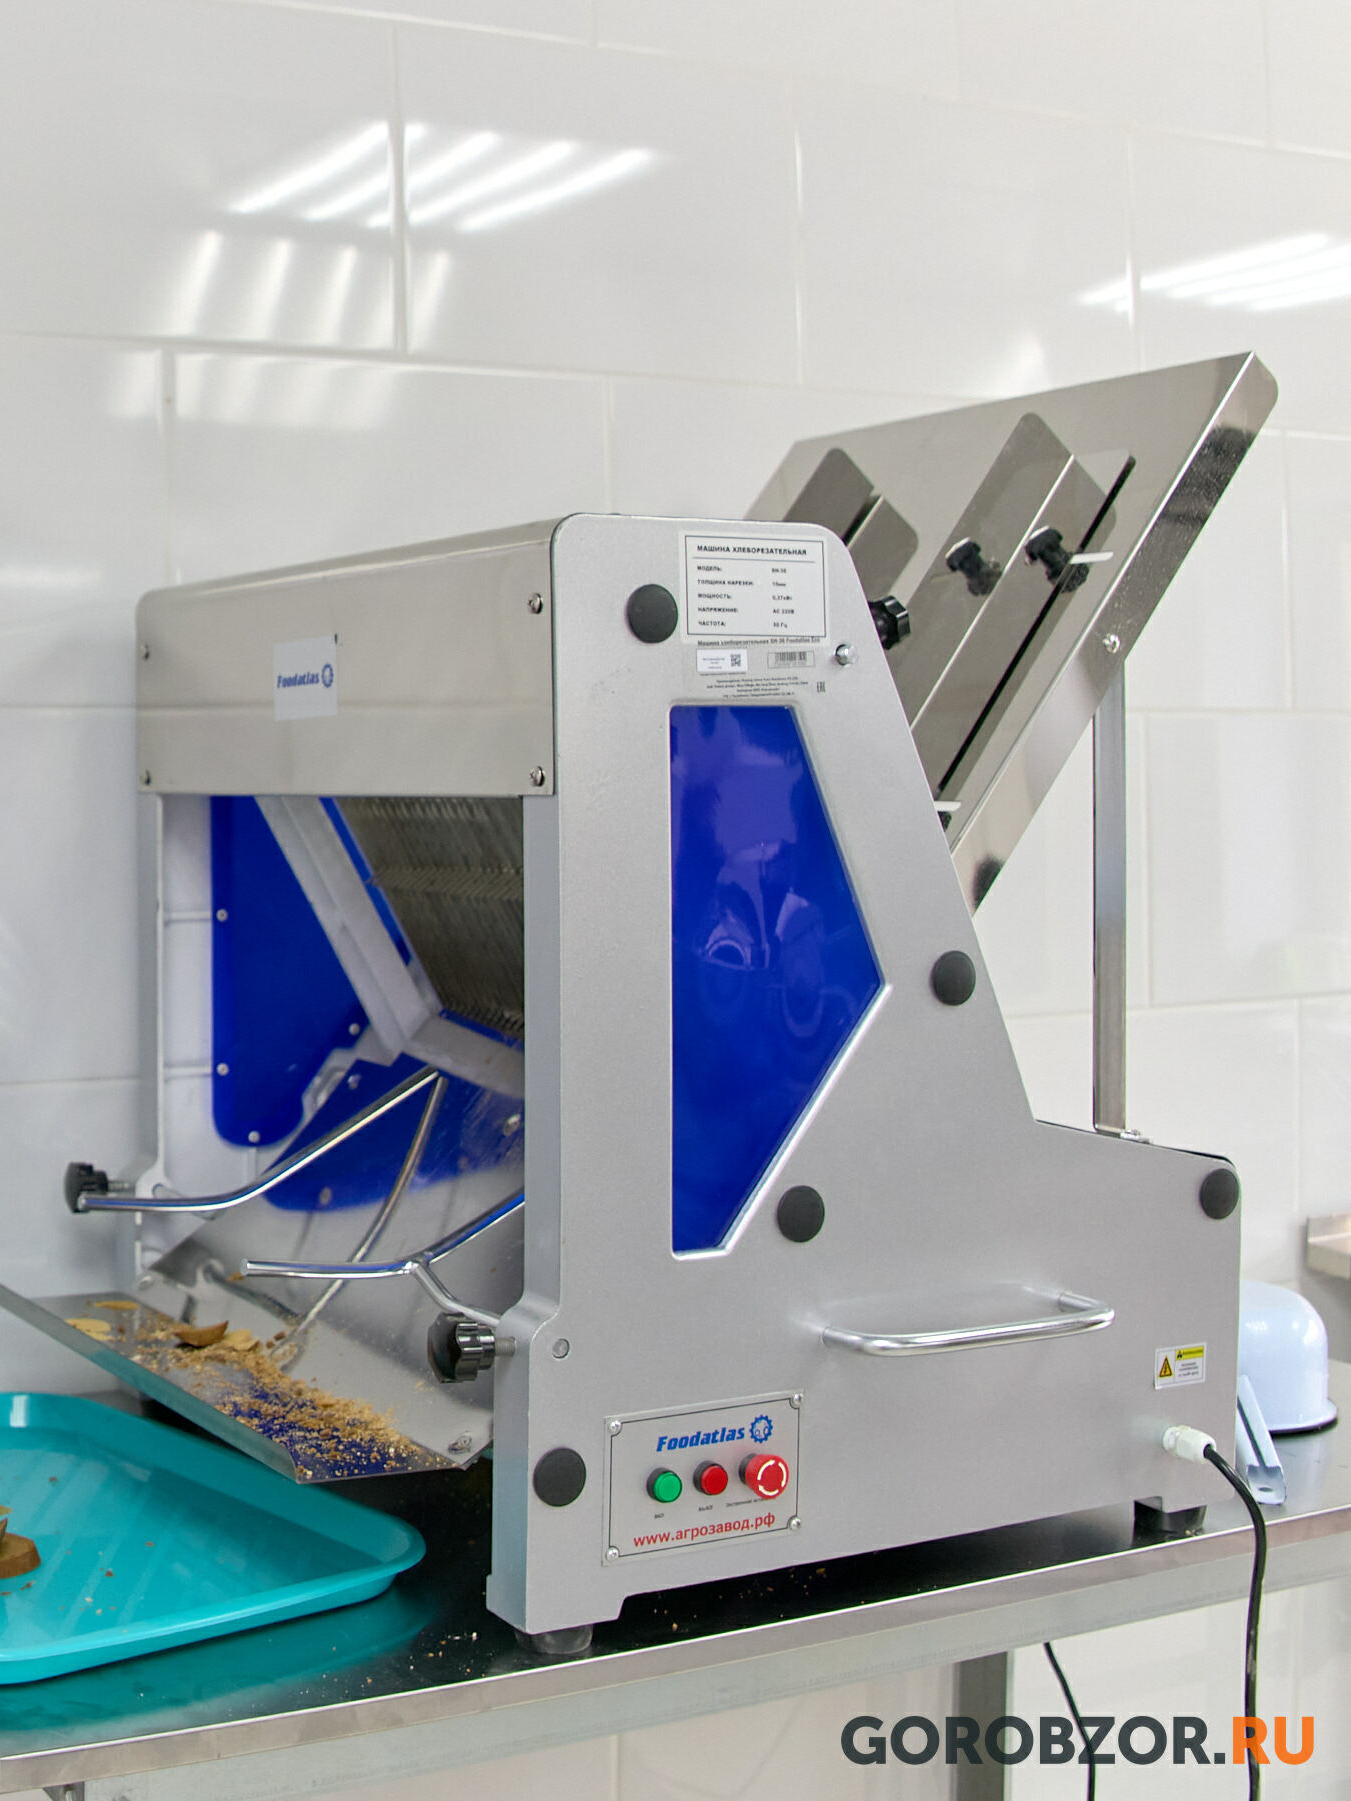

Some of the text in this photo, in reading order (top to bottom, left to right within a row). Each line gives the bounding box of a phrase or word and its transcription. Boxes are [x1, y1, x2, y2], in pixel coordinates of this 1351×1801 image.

[732, 546, 807, 555] ХЛЕБОРЕЗАТЕЛЬНАЯ
[656, 1427, 745, 1452] Foodatlas
[633, 1512, 775, 1547] www.агрозавод.рф
